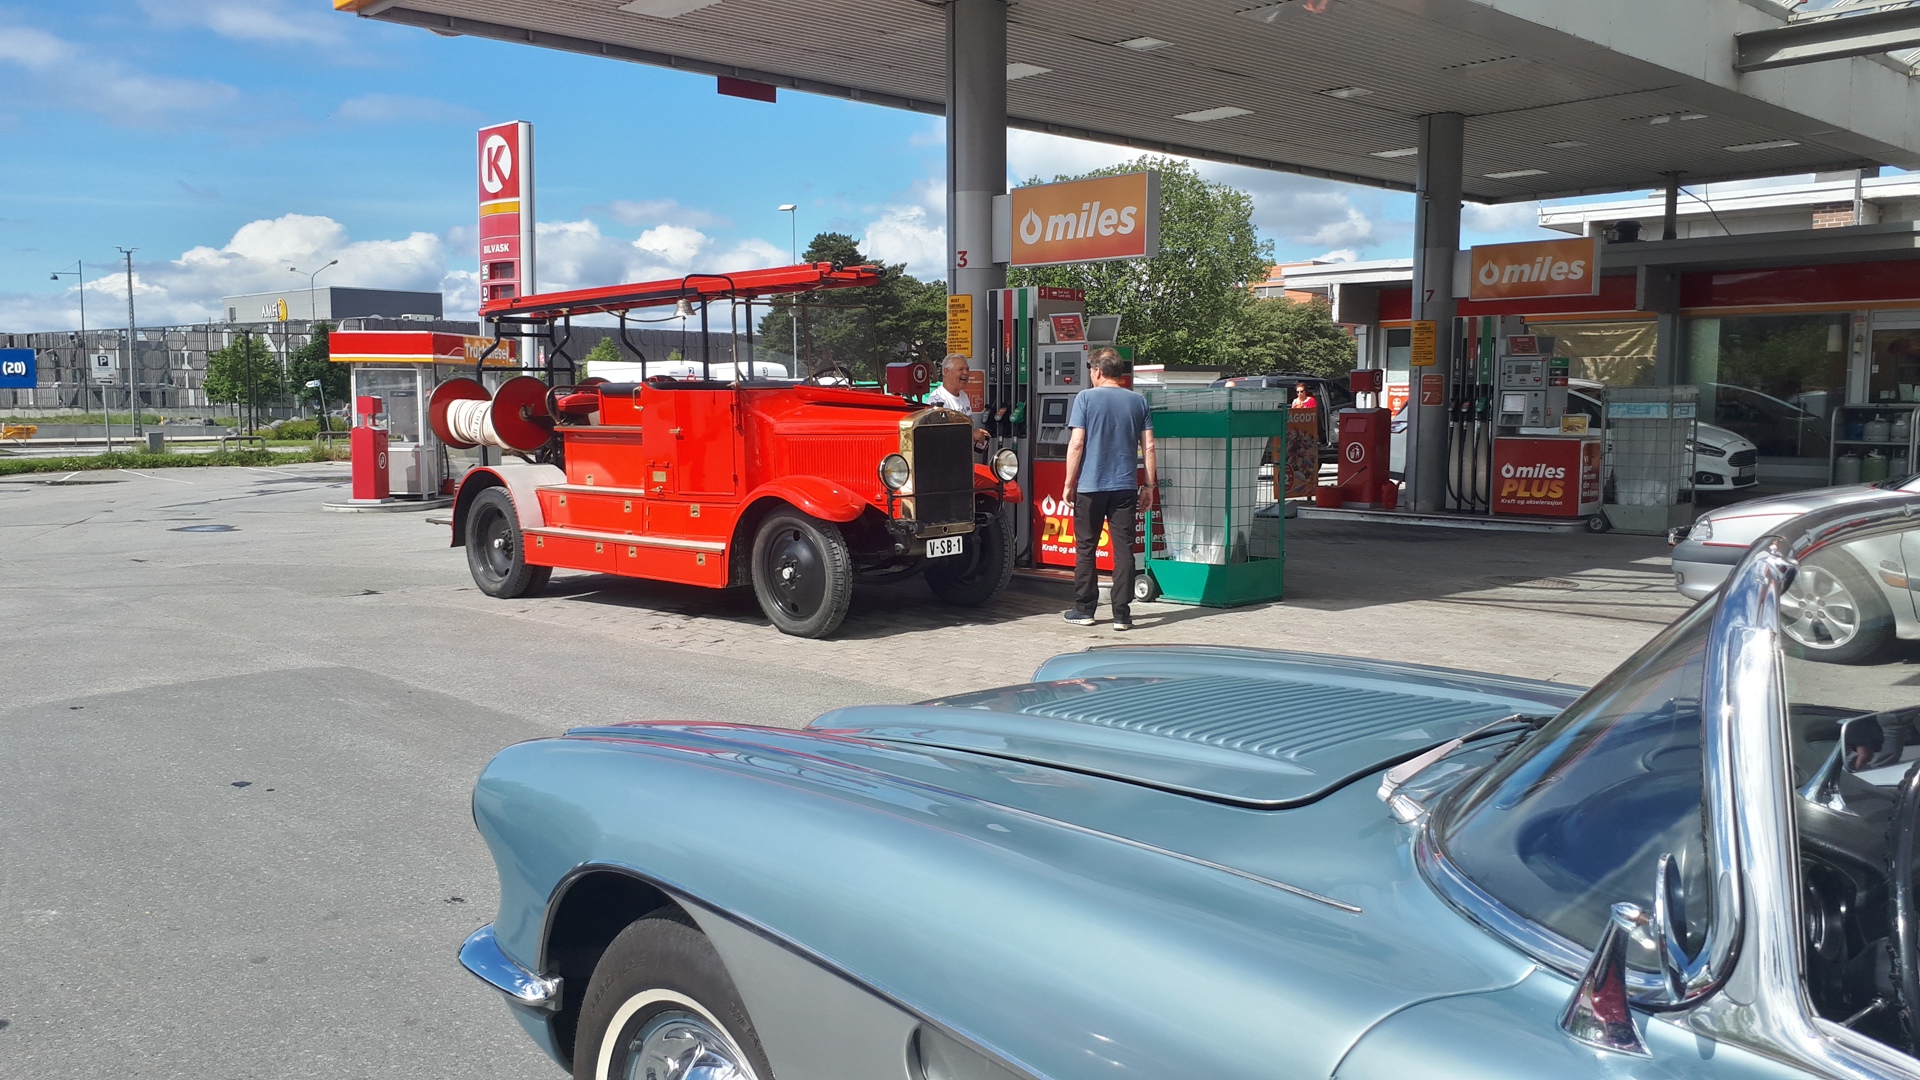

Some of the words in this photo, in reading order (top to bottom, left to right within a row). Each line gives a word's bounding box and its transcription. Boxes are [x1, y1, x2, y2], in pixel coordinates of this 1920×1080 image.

[1044, 201, 1138, 242] miles
[483, 243, 510, 254] BILVASK
[957, 250, 968, 268] 3
[482, 264, 489, 275] 95
[1501, 256, 1586, 284] miles
[1425, 290, 1435, 302] 7
[2, 361, 26, 376] (20)
[1423, 392, 1430, 403] 7
[1515, 463, 1566, 479] miles
[1500, 479, 1565, 499] PLUS
[1041, 517, 1109, 547] PLS
[1041, 544, 1058, 552] Kraft
